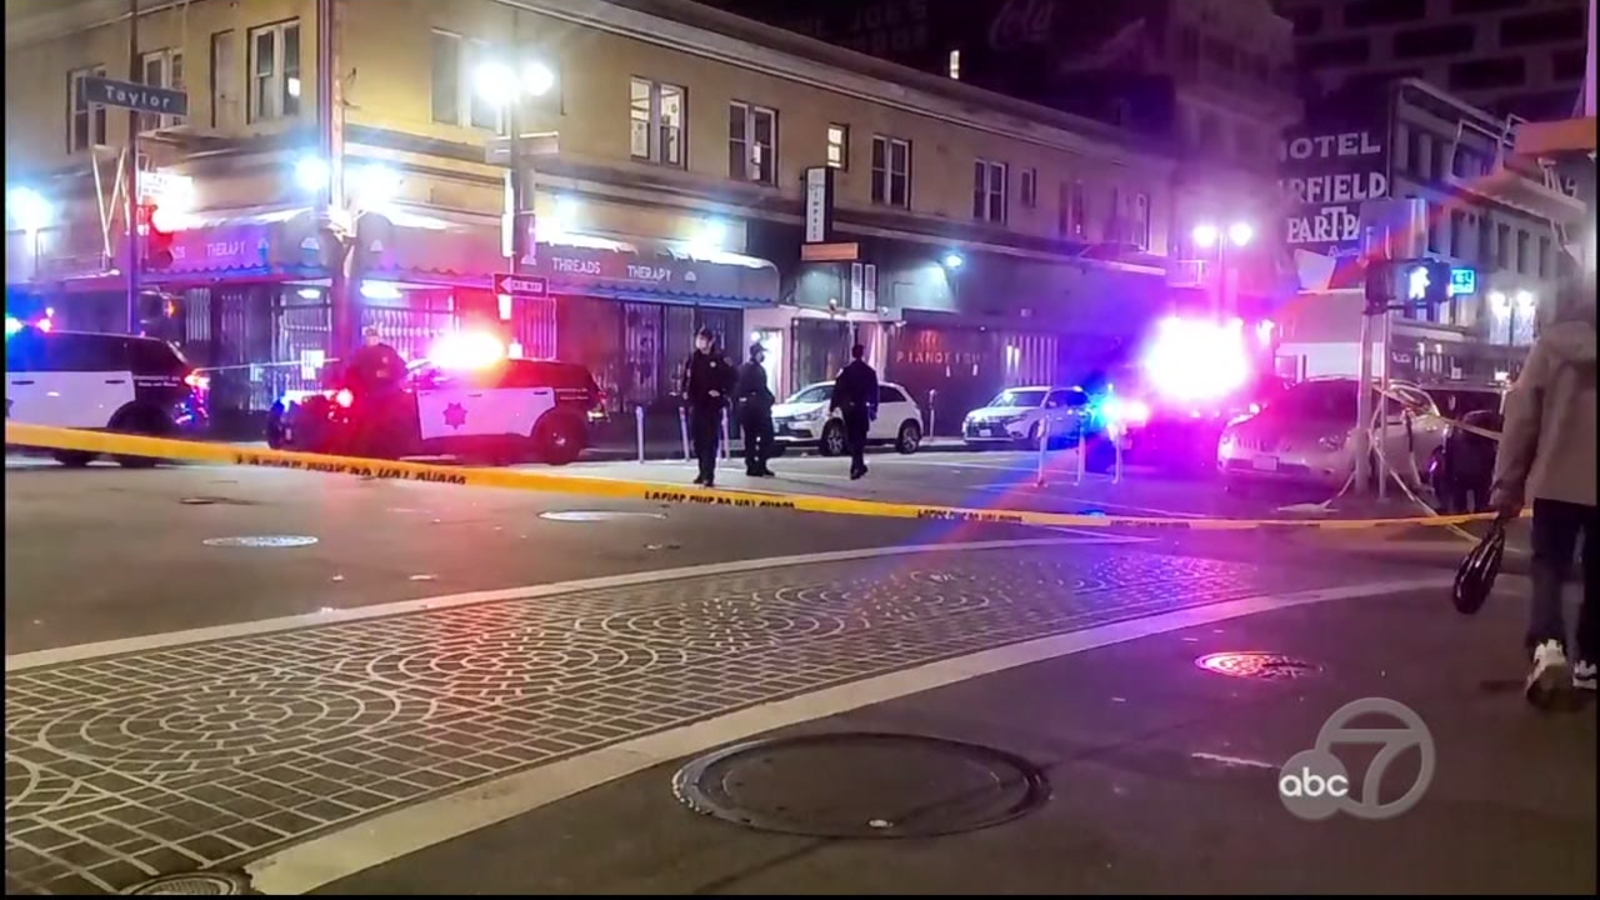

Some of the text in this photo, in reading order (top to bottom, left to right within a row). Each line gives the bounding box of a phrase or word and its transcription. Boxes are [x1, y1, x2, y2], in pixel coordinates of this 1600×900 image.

[105, 85, 171, 109] Taylor
[1279, 172, 1387, 204] RFIELD
[207, 241, 246, 257] THERAPY
[552, 257, 672, 282] THREADS THERAPY
